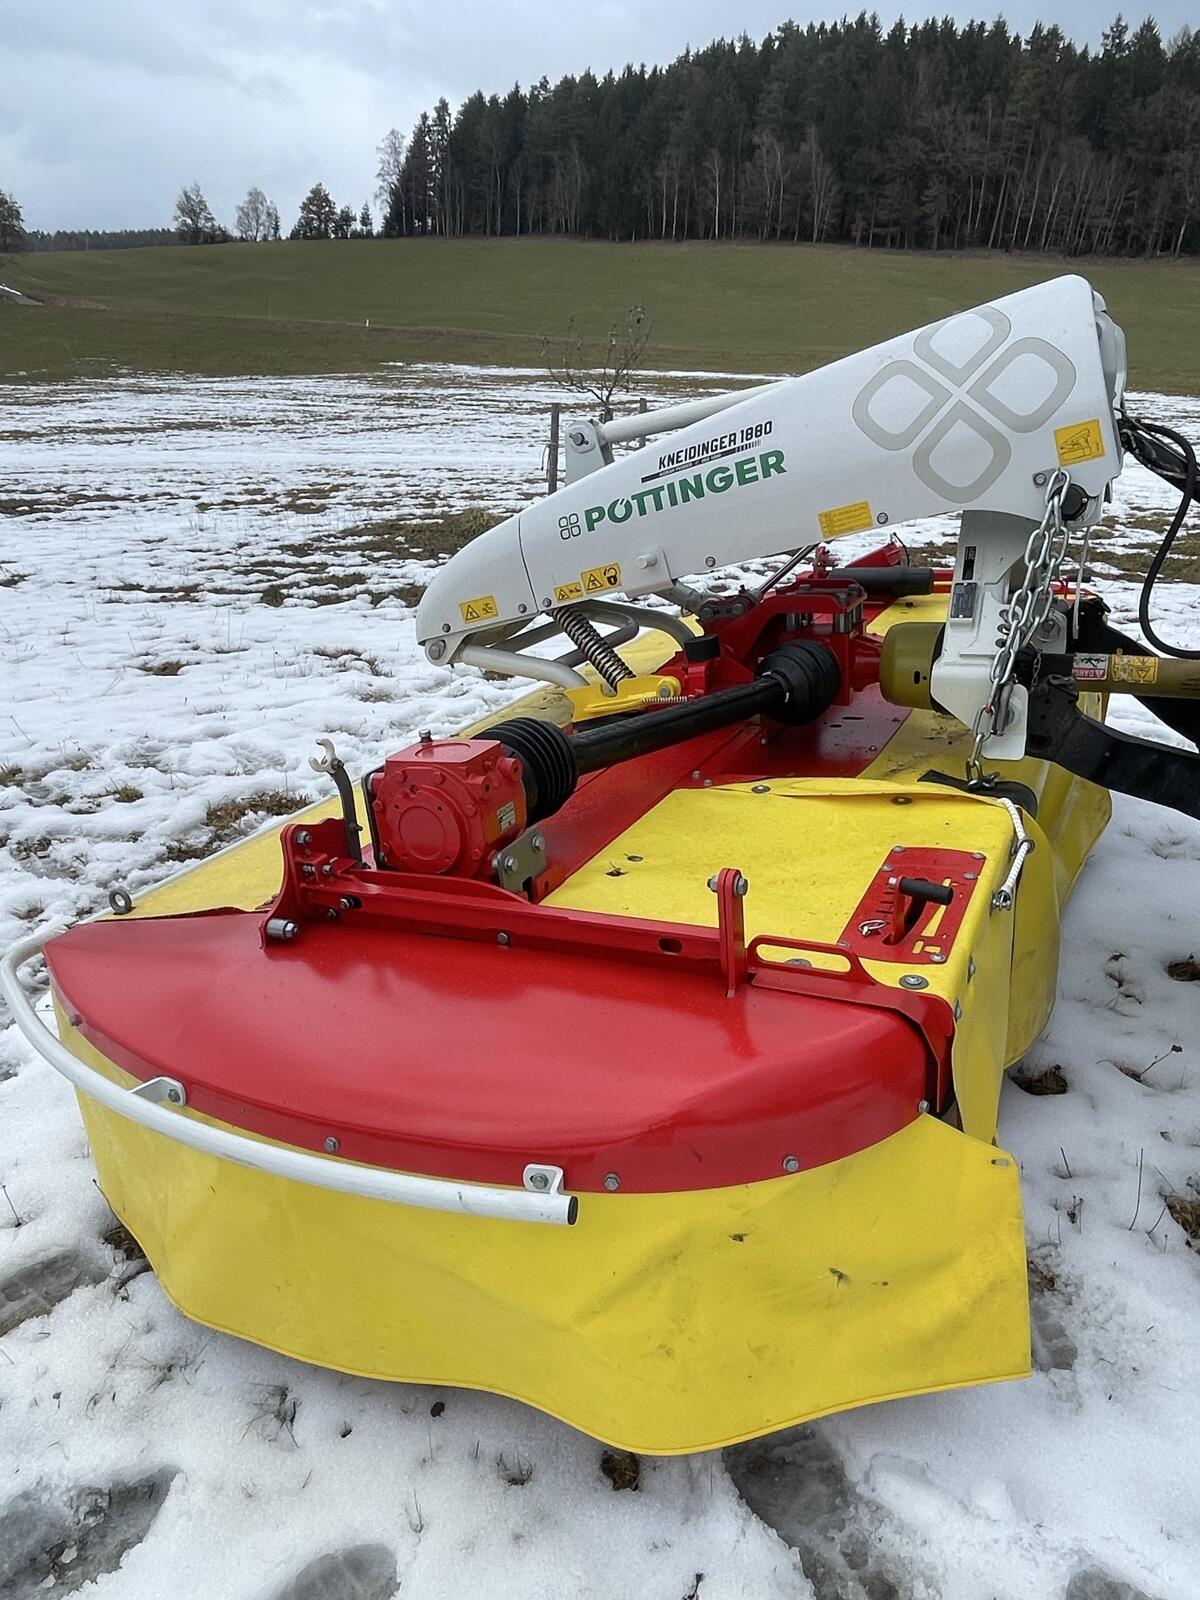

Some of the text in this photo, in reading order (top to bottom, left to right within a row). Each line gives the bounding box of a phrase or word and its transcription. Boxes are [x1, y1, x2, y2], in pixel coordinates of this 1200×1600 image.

[658, 432, 737, 470] KNEIDINGER
[740, 420, 773, 443] 1880
[584, 449, 787, 532] PÖTTINGER
[1072, 668, 1095, 678] DANG
